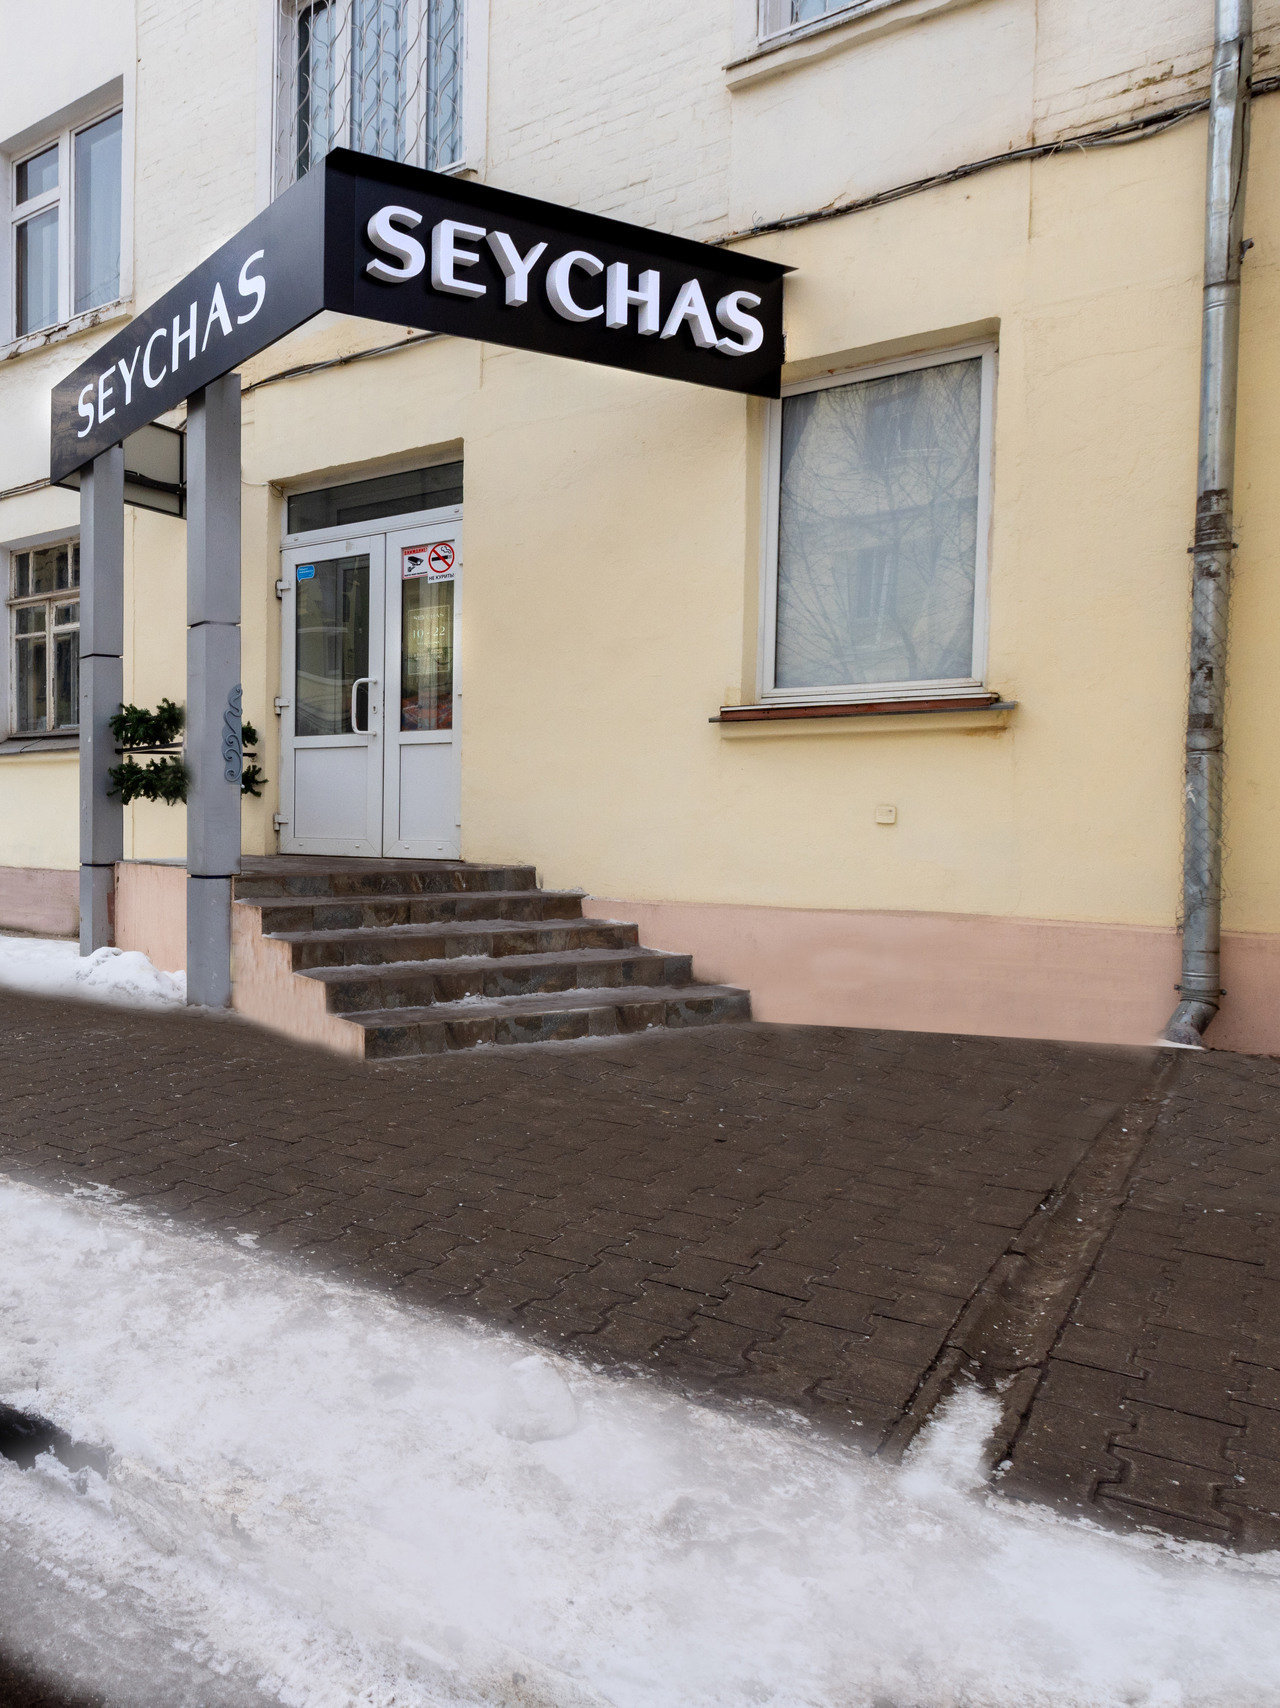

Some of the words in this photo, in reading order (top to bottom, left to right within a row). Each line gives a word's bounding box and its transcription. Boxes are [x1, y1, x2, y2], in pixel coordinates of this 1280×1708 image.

[78, 249, 267, 438] SEYCHAS
[366, 205, 764, 356] SEYCHAS
[412, 629, 424, 639] 10
[432, 626, 446, 637] 22
